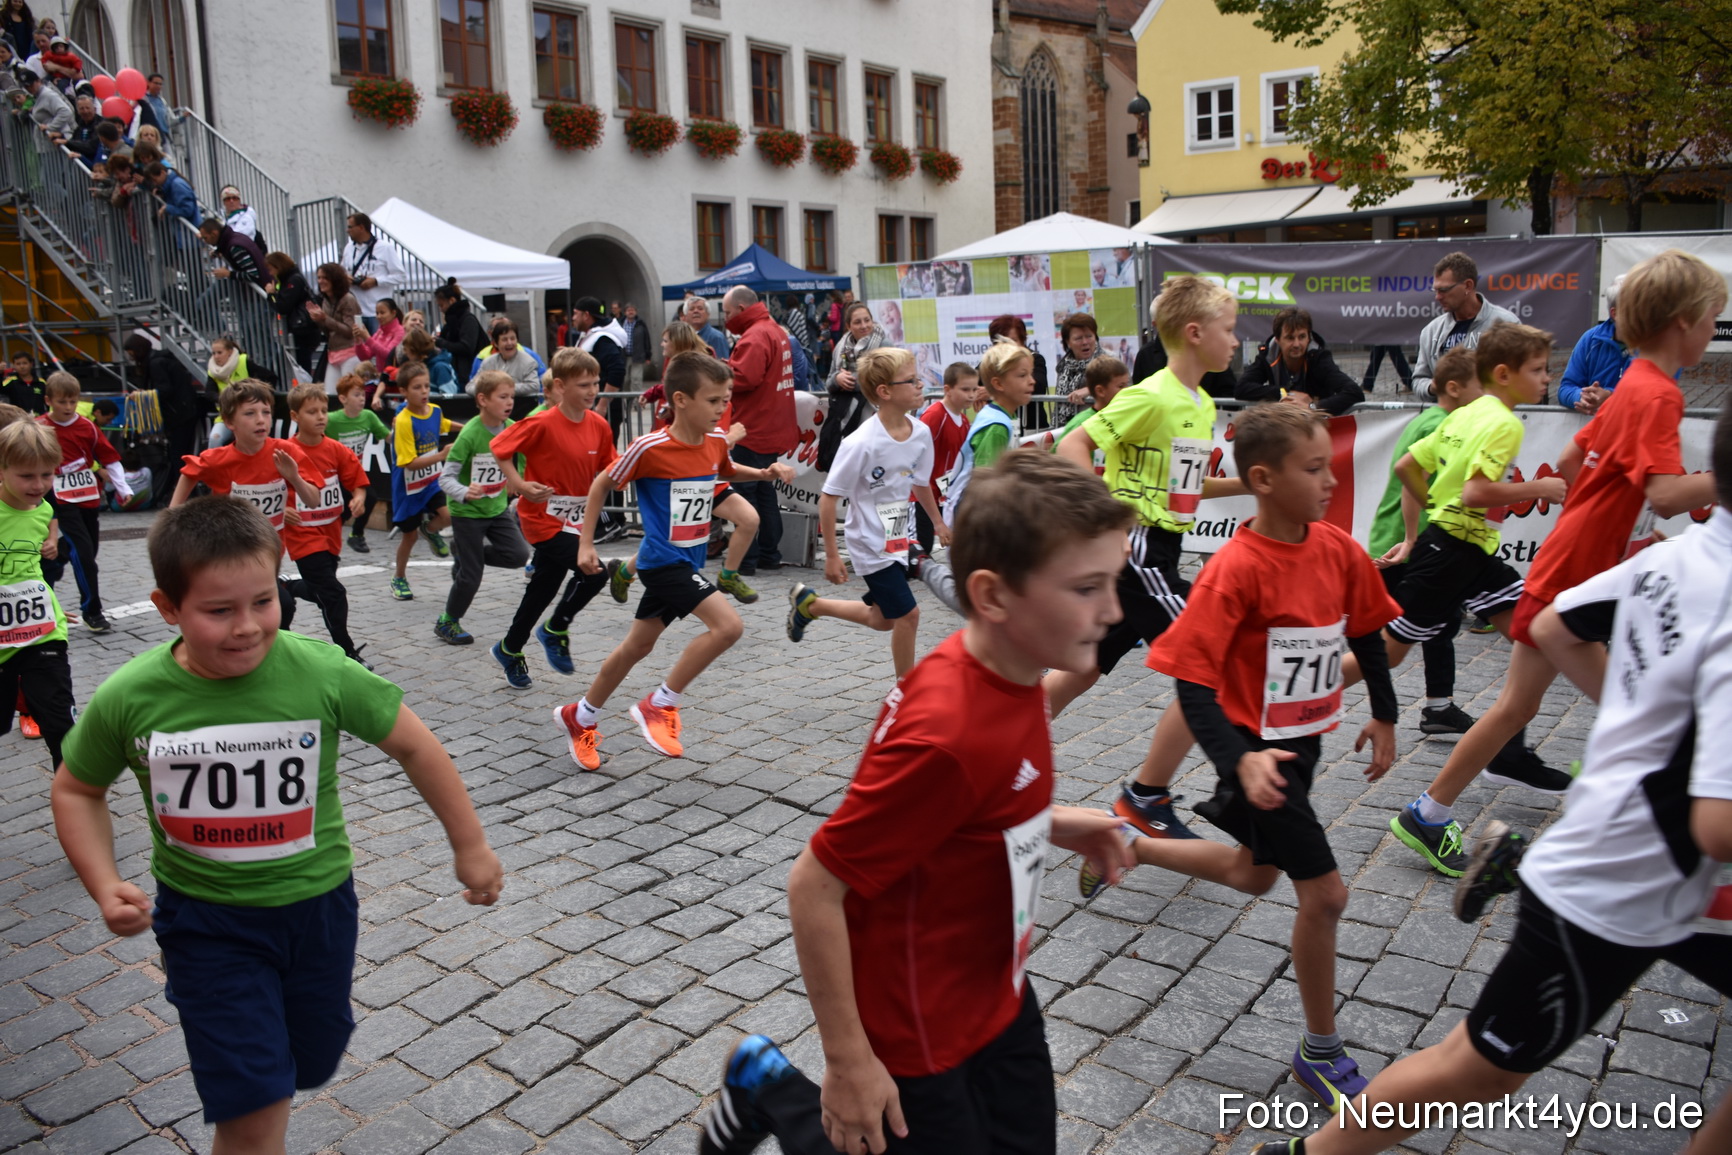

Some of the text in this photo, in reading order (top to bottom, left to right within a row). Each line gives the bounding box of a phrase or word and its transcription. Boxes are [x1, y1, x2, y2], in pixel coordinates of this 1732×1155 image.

[1261, 157, 1306, 180] Der
[1164, 272, 1296, 304] CK
[1305, 276, 1372, 293] OFFICE
[1488, 273, 1579, 291] LOUNGE
[1251, 307, 1281, 316] conce
[57, 471, 93, 489] 7008
[0, 587, 37, 598] Neumarkt
[1271, 639, 1314, 650] PARTL
[1283, 651, 1340, 696] 710
[154, 737, 293, 757] PARTL Neumarkt
[170, 756, 305, 810] 7018
[192, 821, 286, 844] Benedikt
